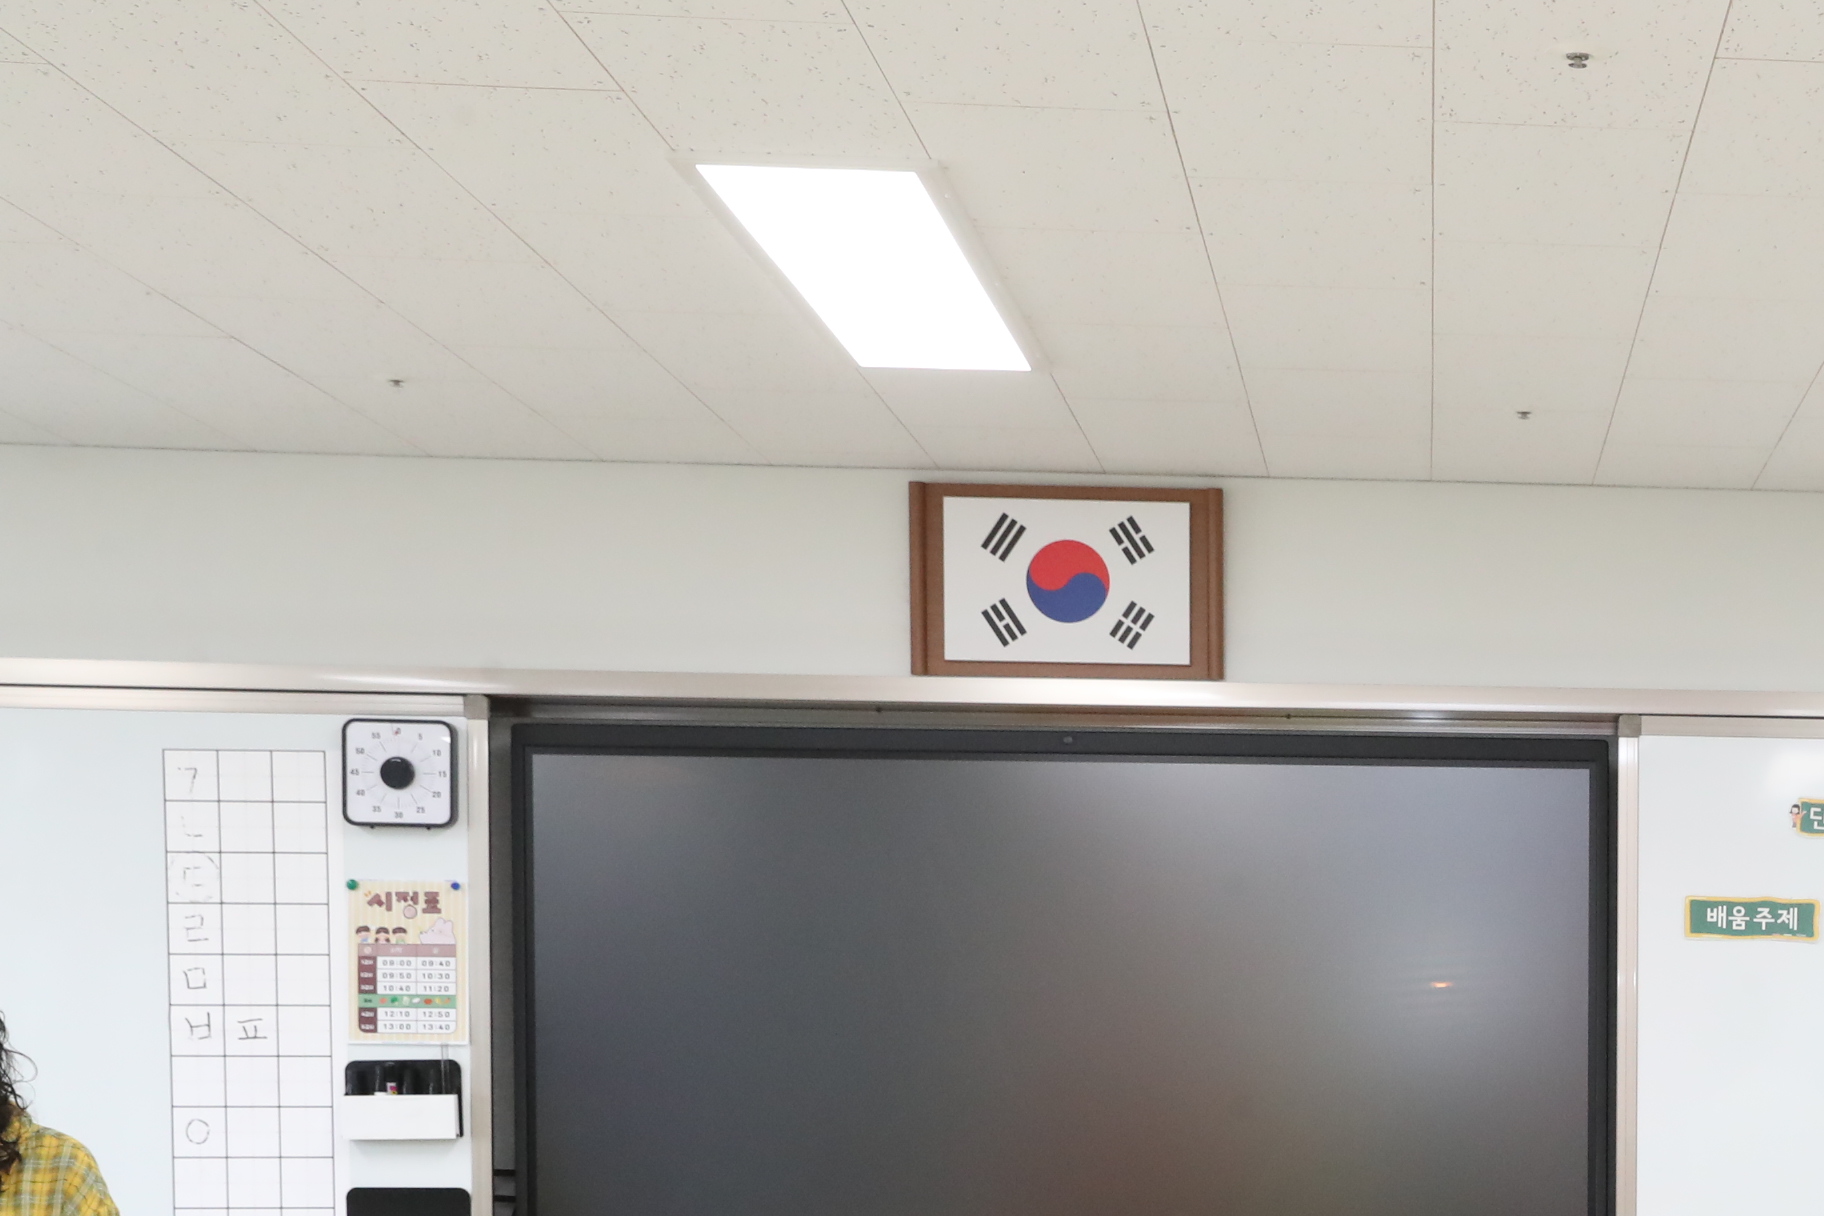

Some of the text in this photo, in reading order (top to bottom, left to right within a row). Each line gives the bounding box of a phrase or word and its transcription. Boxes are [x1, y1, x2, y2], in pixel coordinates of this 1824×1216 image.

[355, 747, 365, 755] 50
[432, 749, 442, 757] 10
[350, 768, 360, 776] 45
[438, 770, 447, 778] 15
[356, 789, 366, 797] 40
[432, 791, 442, 799] 20
[416, 806, 426, 814] 25
[394, 811, 404, 819] 30
